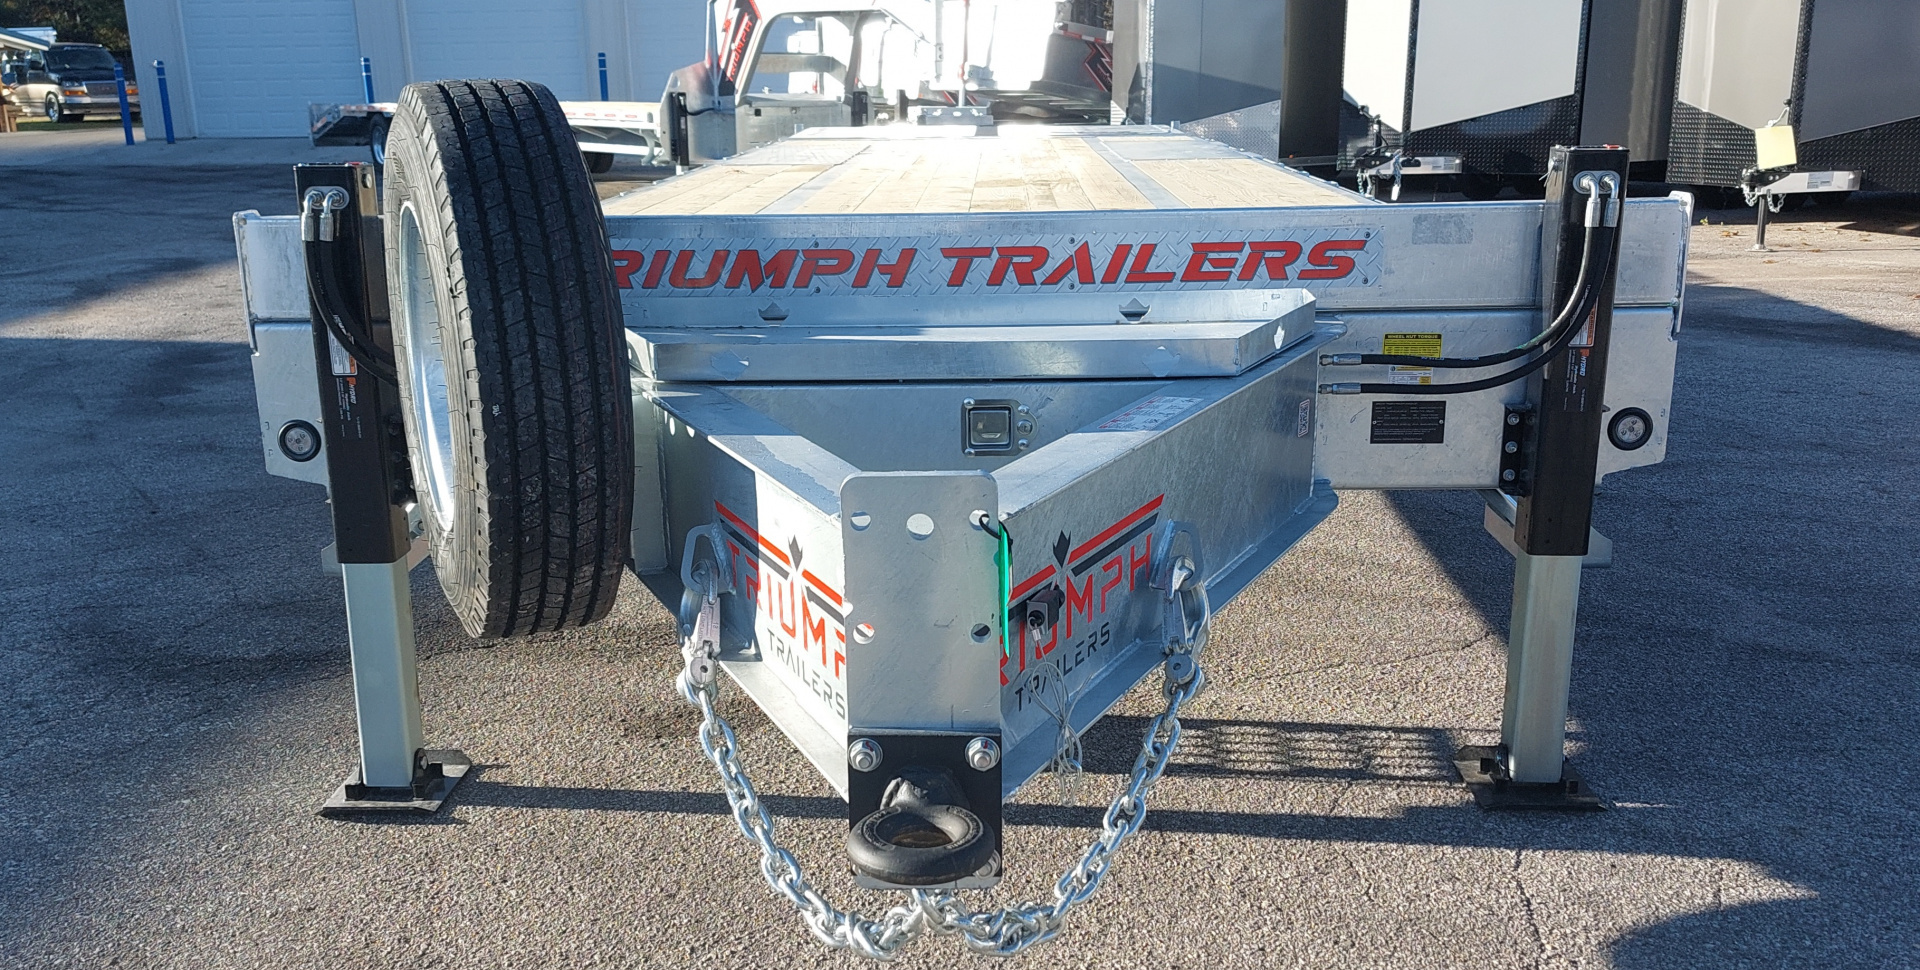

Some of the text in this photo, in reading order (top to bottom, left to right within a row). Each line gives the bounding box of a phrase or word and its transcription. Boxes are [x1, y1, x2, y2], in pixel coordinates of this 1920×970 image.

[611, 239, 1369, 293] RIUMPH TRAILERS
[726, 538, 846, 680] TRIUMP
[766, 626, 846, 721] TRAILERS
